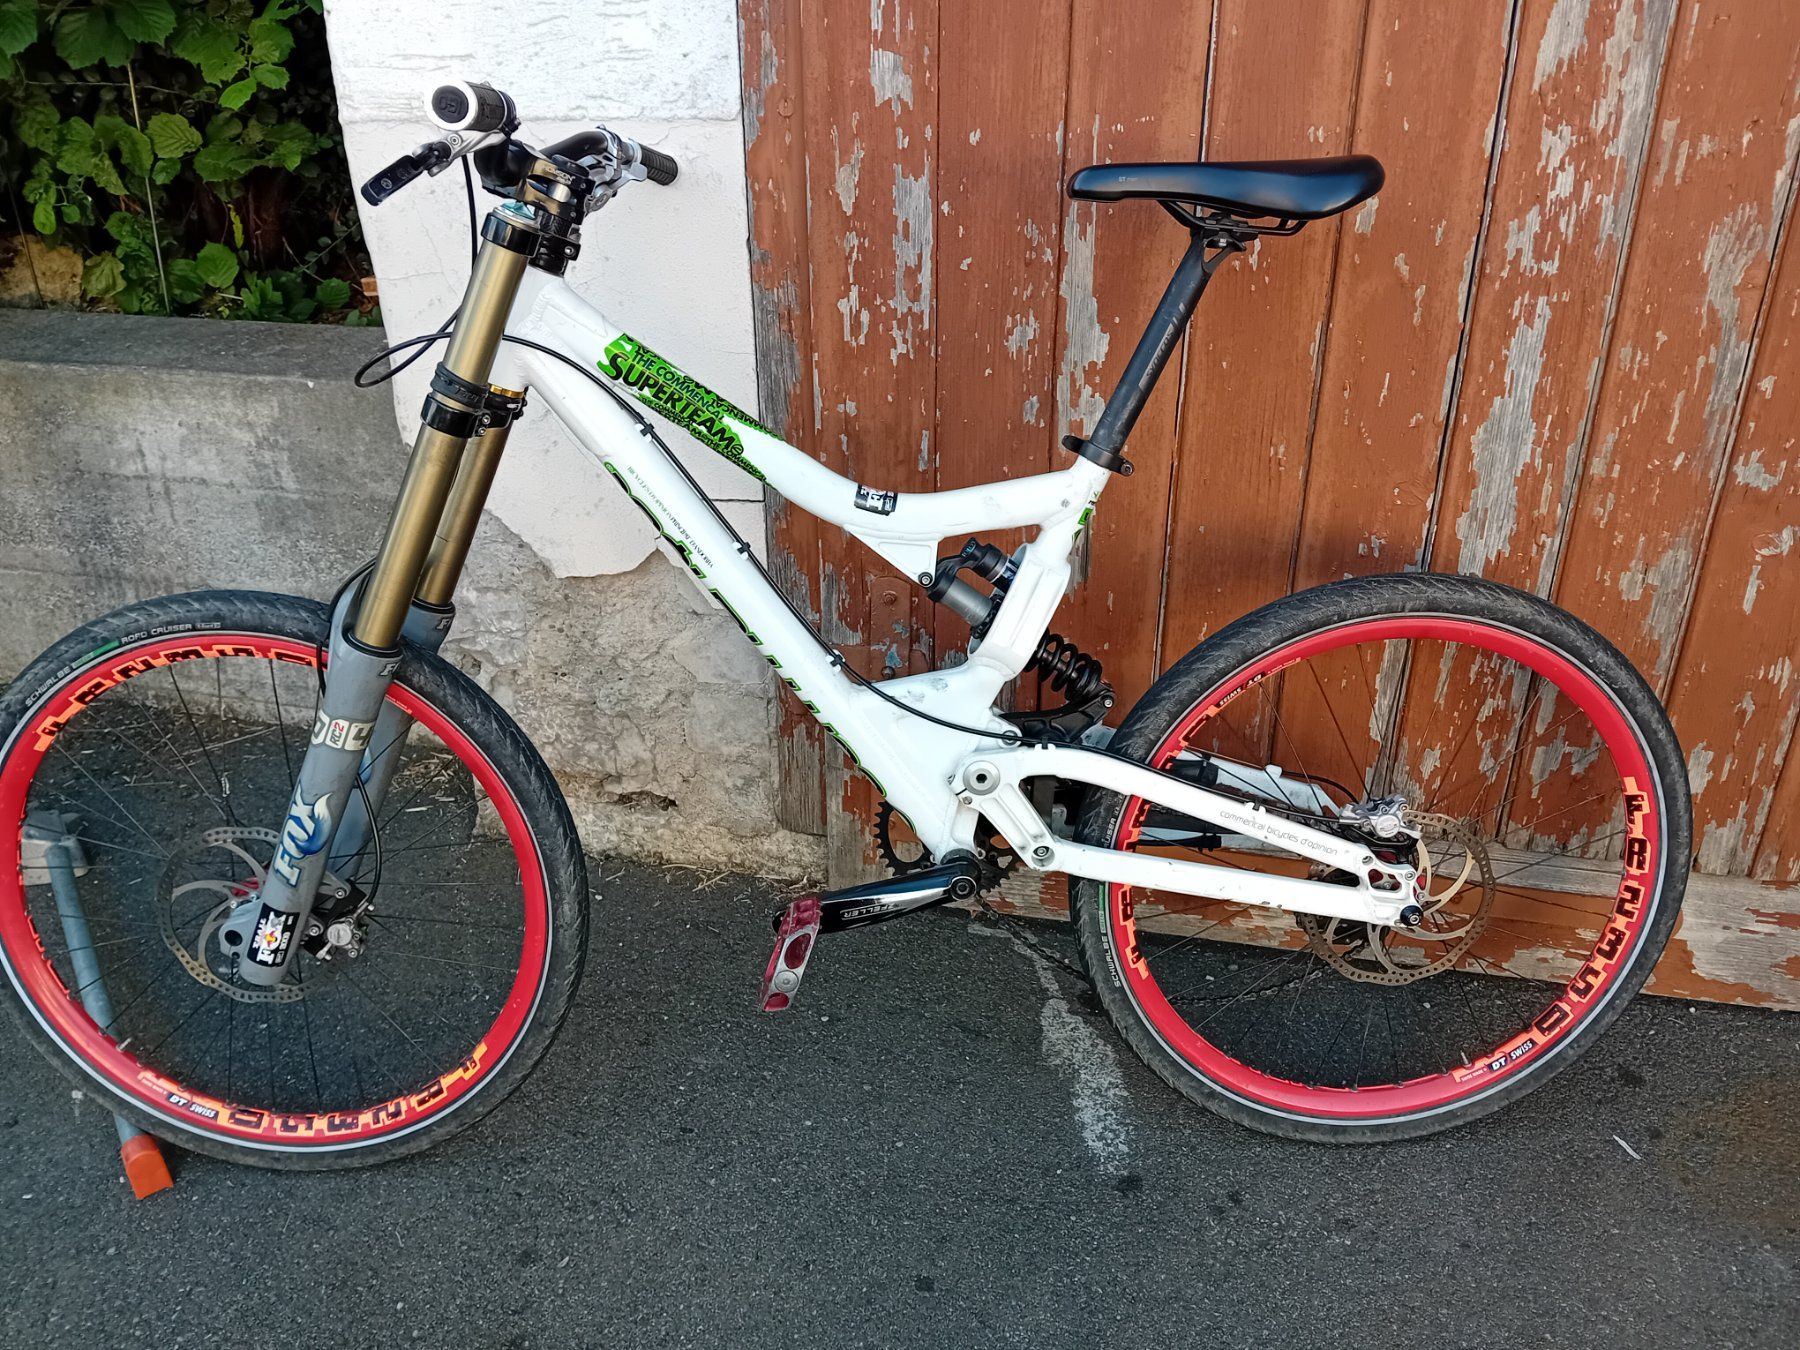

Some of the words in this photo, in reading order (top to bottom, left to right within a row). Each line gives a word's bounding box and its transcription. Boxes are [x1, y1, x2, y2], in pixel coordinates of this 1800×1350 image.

[609, 352, 736, 450] SUPERTEAM
[632, 350, 657, 370] THE
[656, 366, 725, 420] COMMENCAL
[24, 664, 71, 707] SCHWALBE
[150, 622, 192, 636] CRUISER
[273, 786, 319, 886] FOX
[1219, 808, 1266, 832] commencal
[1266, 823, 1299, 844] bicycles
[1099, 934, 1122, 988] SCHWALBE
[1490, 1055, 1508, 1070] DT
[1508, 1040, 1533, 1059] SWISS
[168, 1093, 187, 1108] DT
[188, 1102, 215, 1119] SWISS
